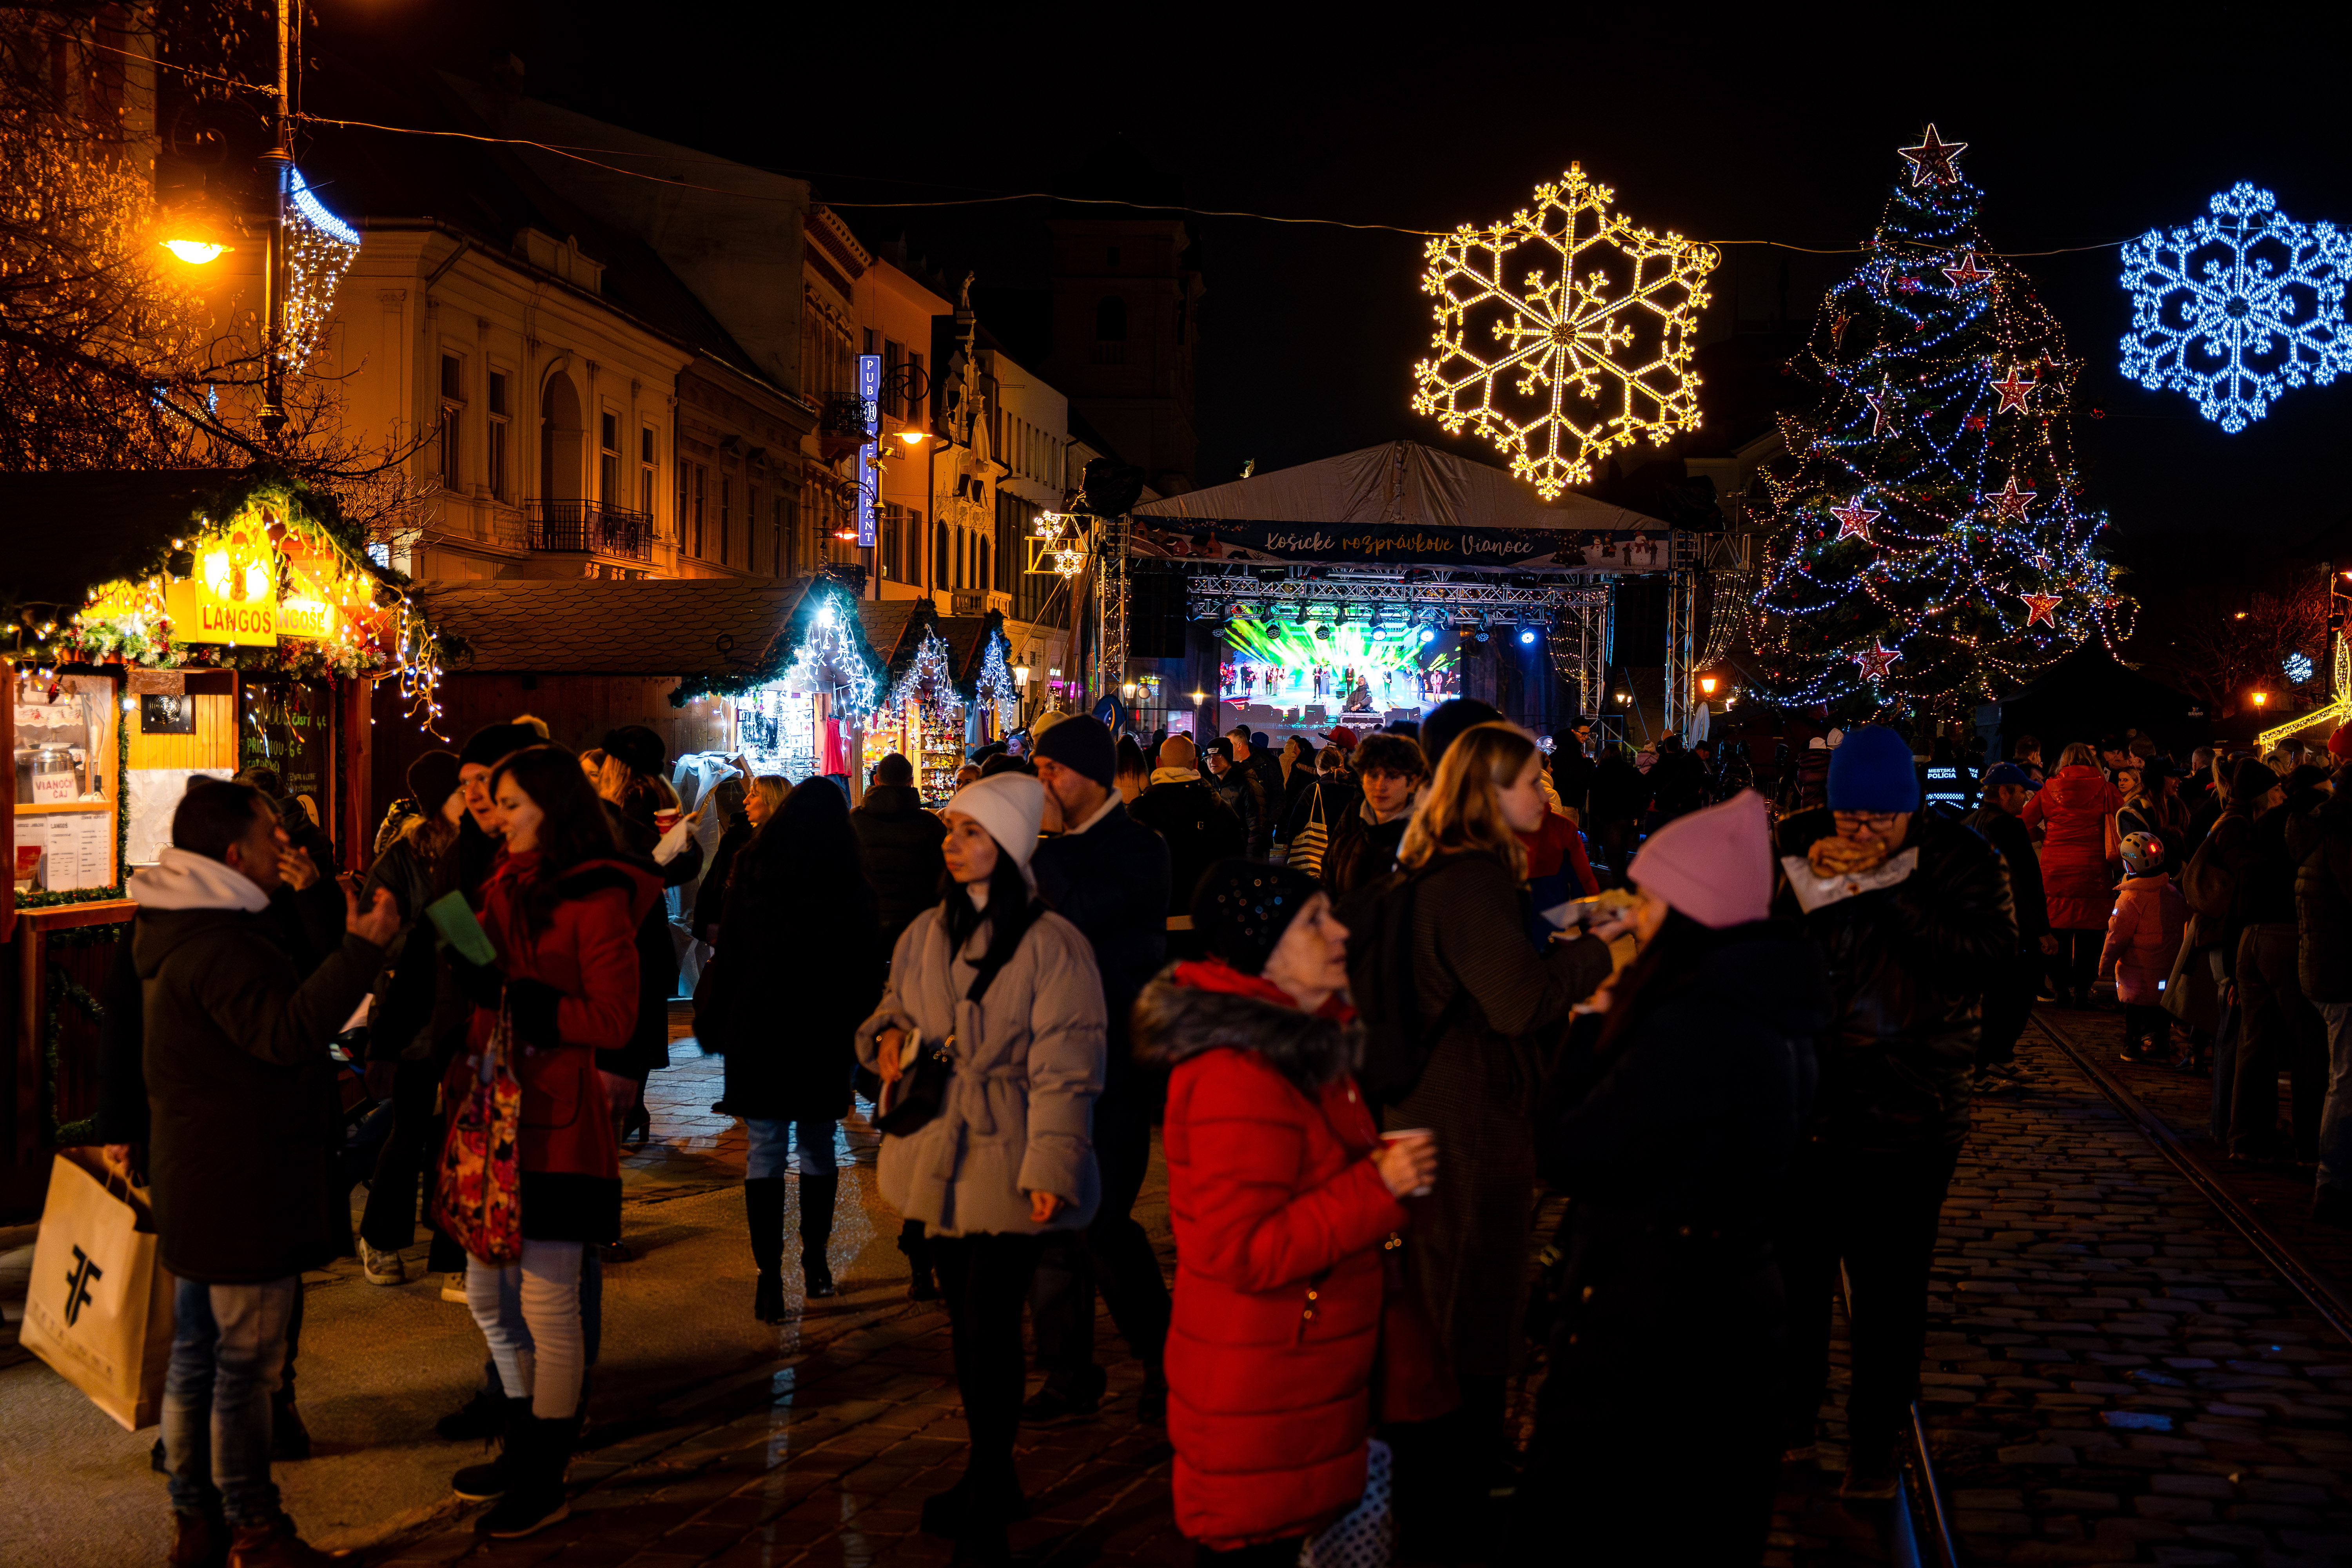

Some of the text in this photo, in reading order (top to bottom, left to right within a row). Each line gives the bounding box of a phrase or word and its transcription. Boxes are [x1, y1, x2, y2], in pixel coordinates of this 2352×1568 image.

[1265, 532, 1534, 556] Košické rozprávkové Vianoce
[203, 605, 271, 634] LANGOŠ
[53, 789, 67, 798] ČAJ
